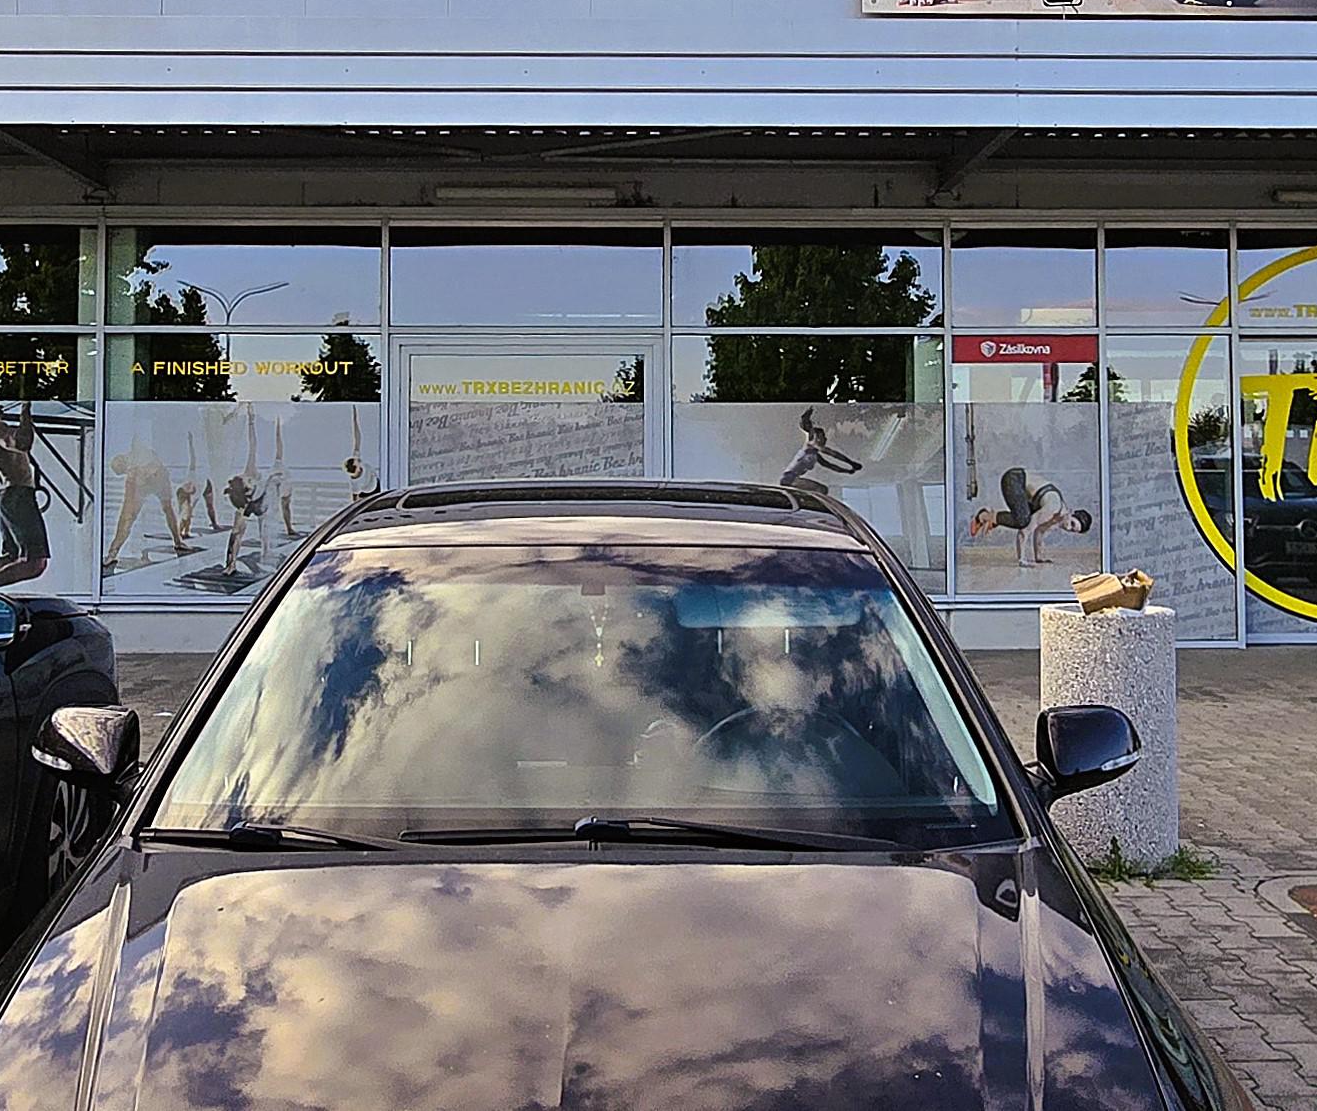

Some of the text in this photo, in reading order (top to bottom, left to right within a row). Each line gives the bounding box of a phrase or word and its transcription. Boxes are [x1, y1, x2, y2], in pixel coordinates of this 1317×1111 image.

[999, 343, 1051, 355] Zásilkovna
[132, 361, 353, 376] A FINISHED WORKOUT
